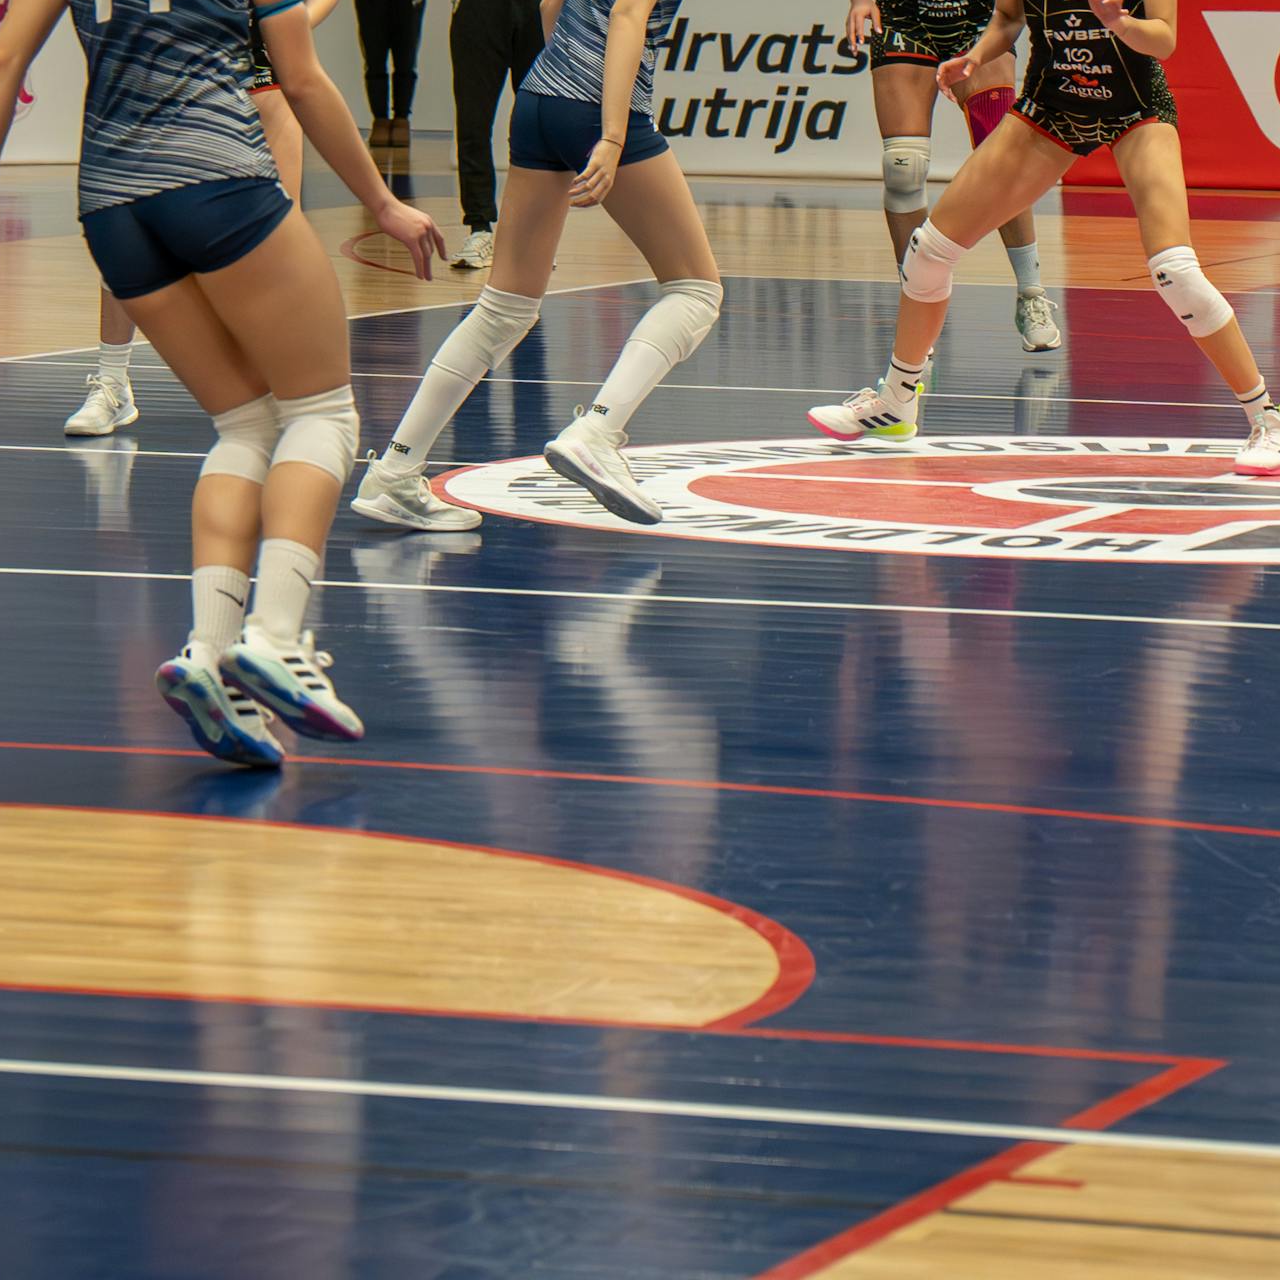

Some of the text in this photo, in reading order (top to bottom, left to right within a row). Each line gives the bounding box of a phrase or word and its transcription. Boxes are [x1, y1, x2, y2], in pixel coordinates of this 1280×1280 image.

[656, 17, 871, 75] Hrvats
[1042, 28, 1112, 42] FAVBET
[1058, 76, 1113, 99] Zagreb
[658, 85, 848, 154] utrija
